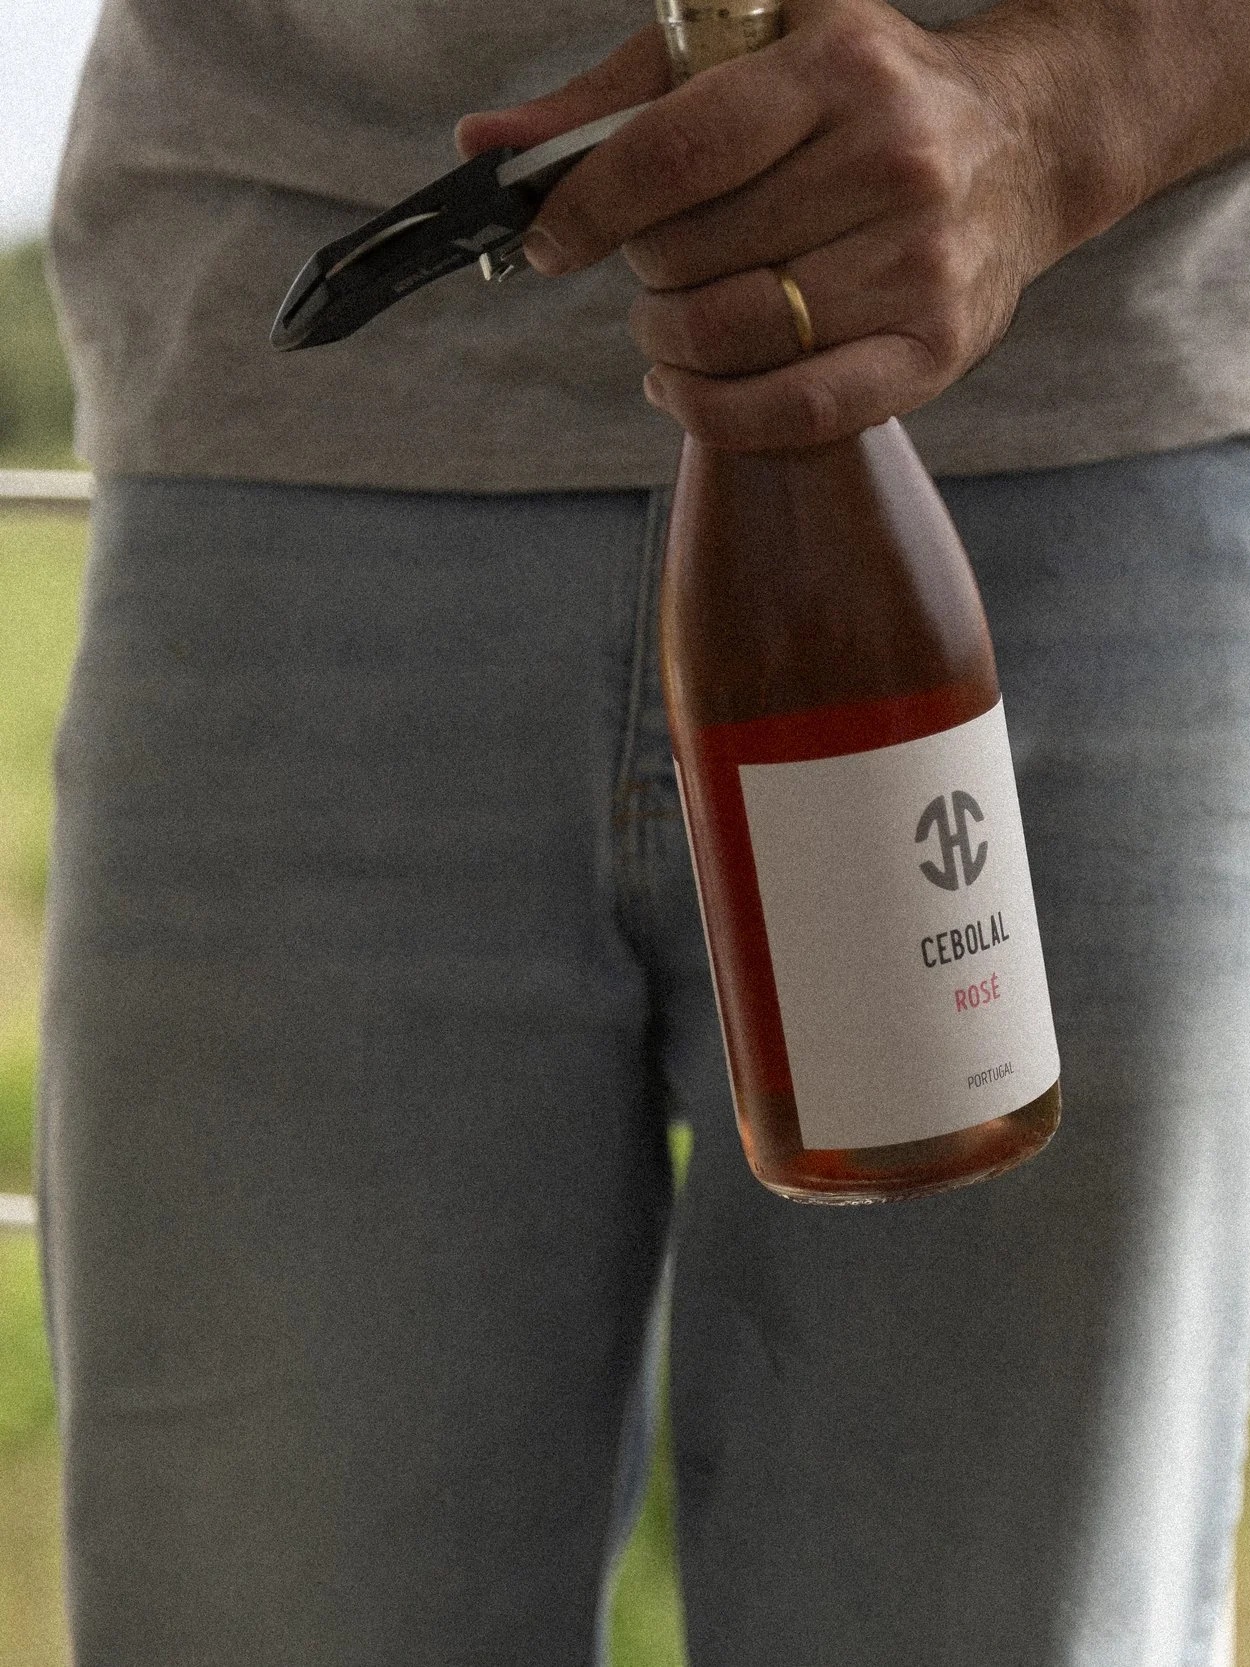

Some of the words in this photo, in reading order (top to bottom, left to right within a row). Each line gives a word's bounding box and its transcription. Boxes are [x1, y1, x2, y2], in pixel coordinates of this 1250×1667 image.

[921, 912, 1010, 969] CEBOLAL
[955, 972, 1001, 1012] ROSÉ
[967, 1061, 1015, 1090] PORTUGAL
